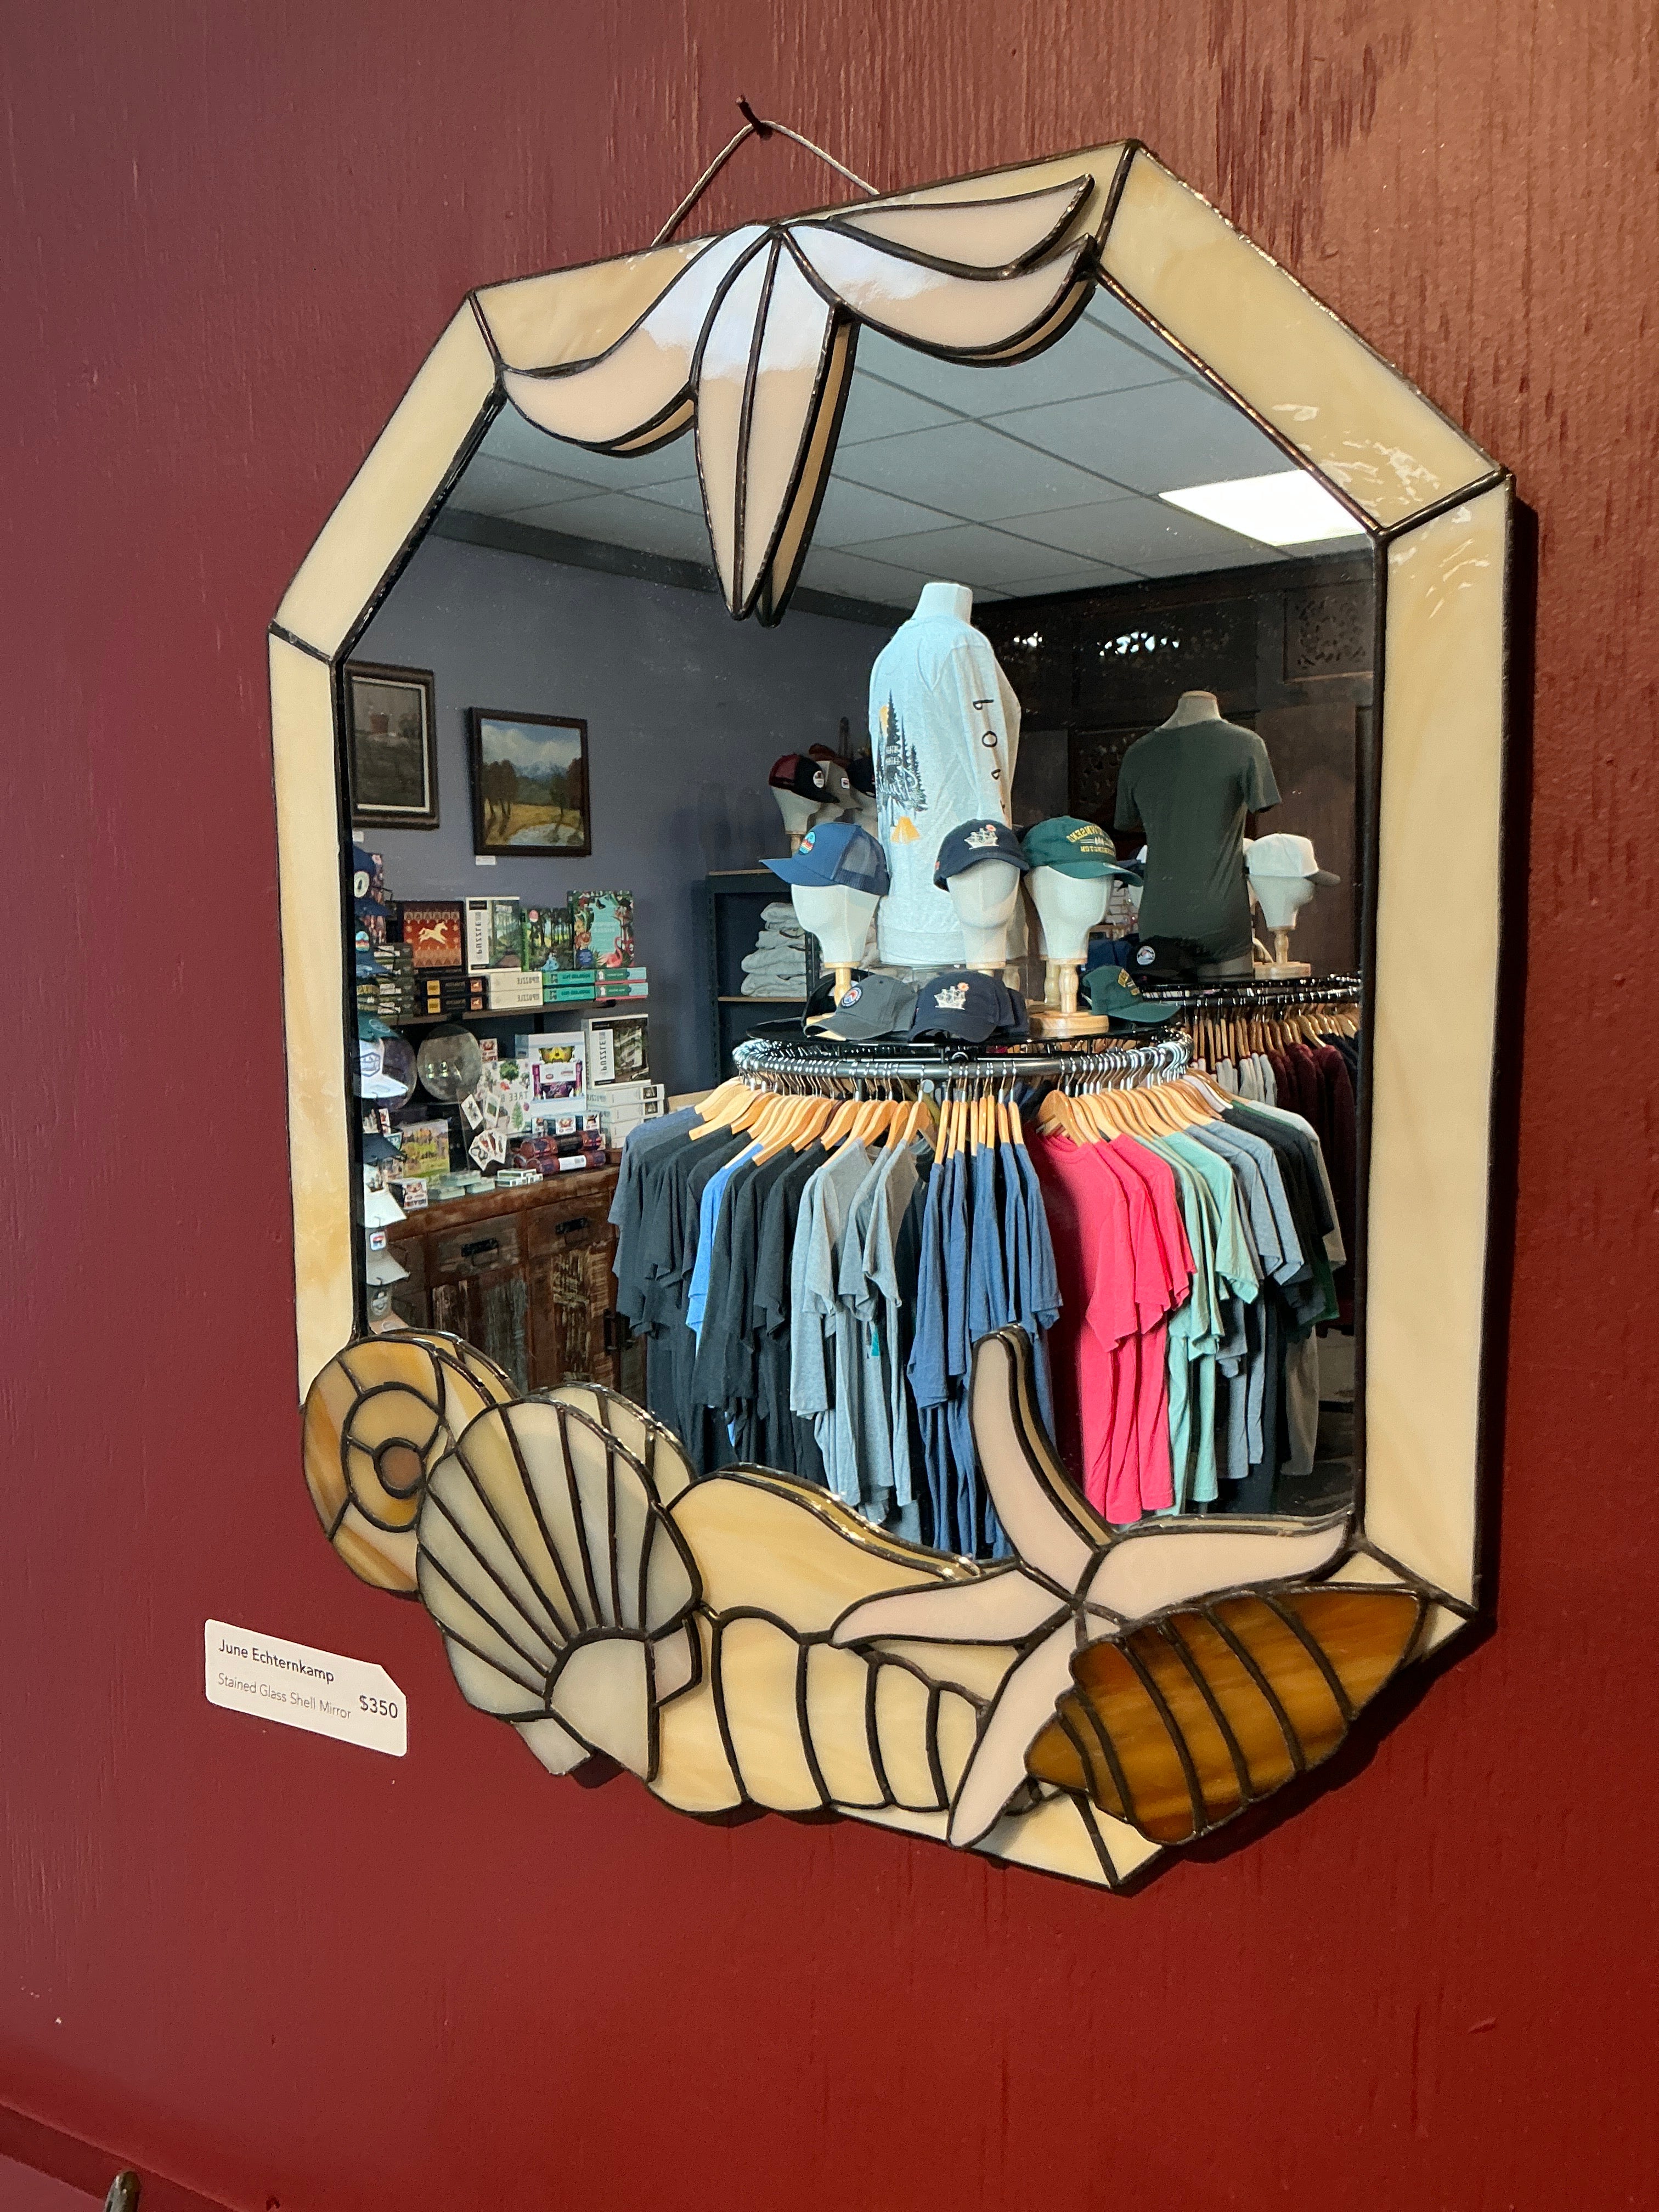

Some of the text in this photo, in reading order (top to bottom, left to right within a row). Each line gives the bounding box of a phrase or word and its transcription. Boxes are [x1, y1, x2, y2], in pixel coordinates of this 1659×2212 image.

[219, 1639, 334, 1684] June Echternkamp
[218, 1672, 352, 1719] Stained Glass Shell Mirror
[359, 1694, 398, 1719] $350
